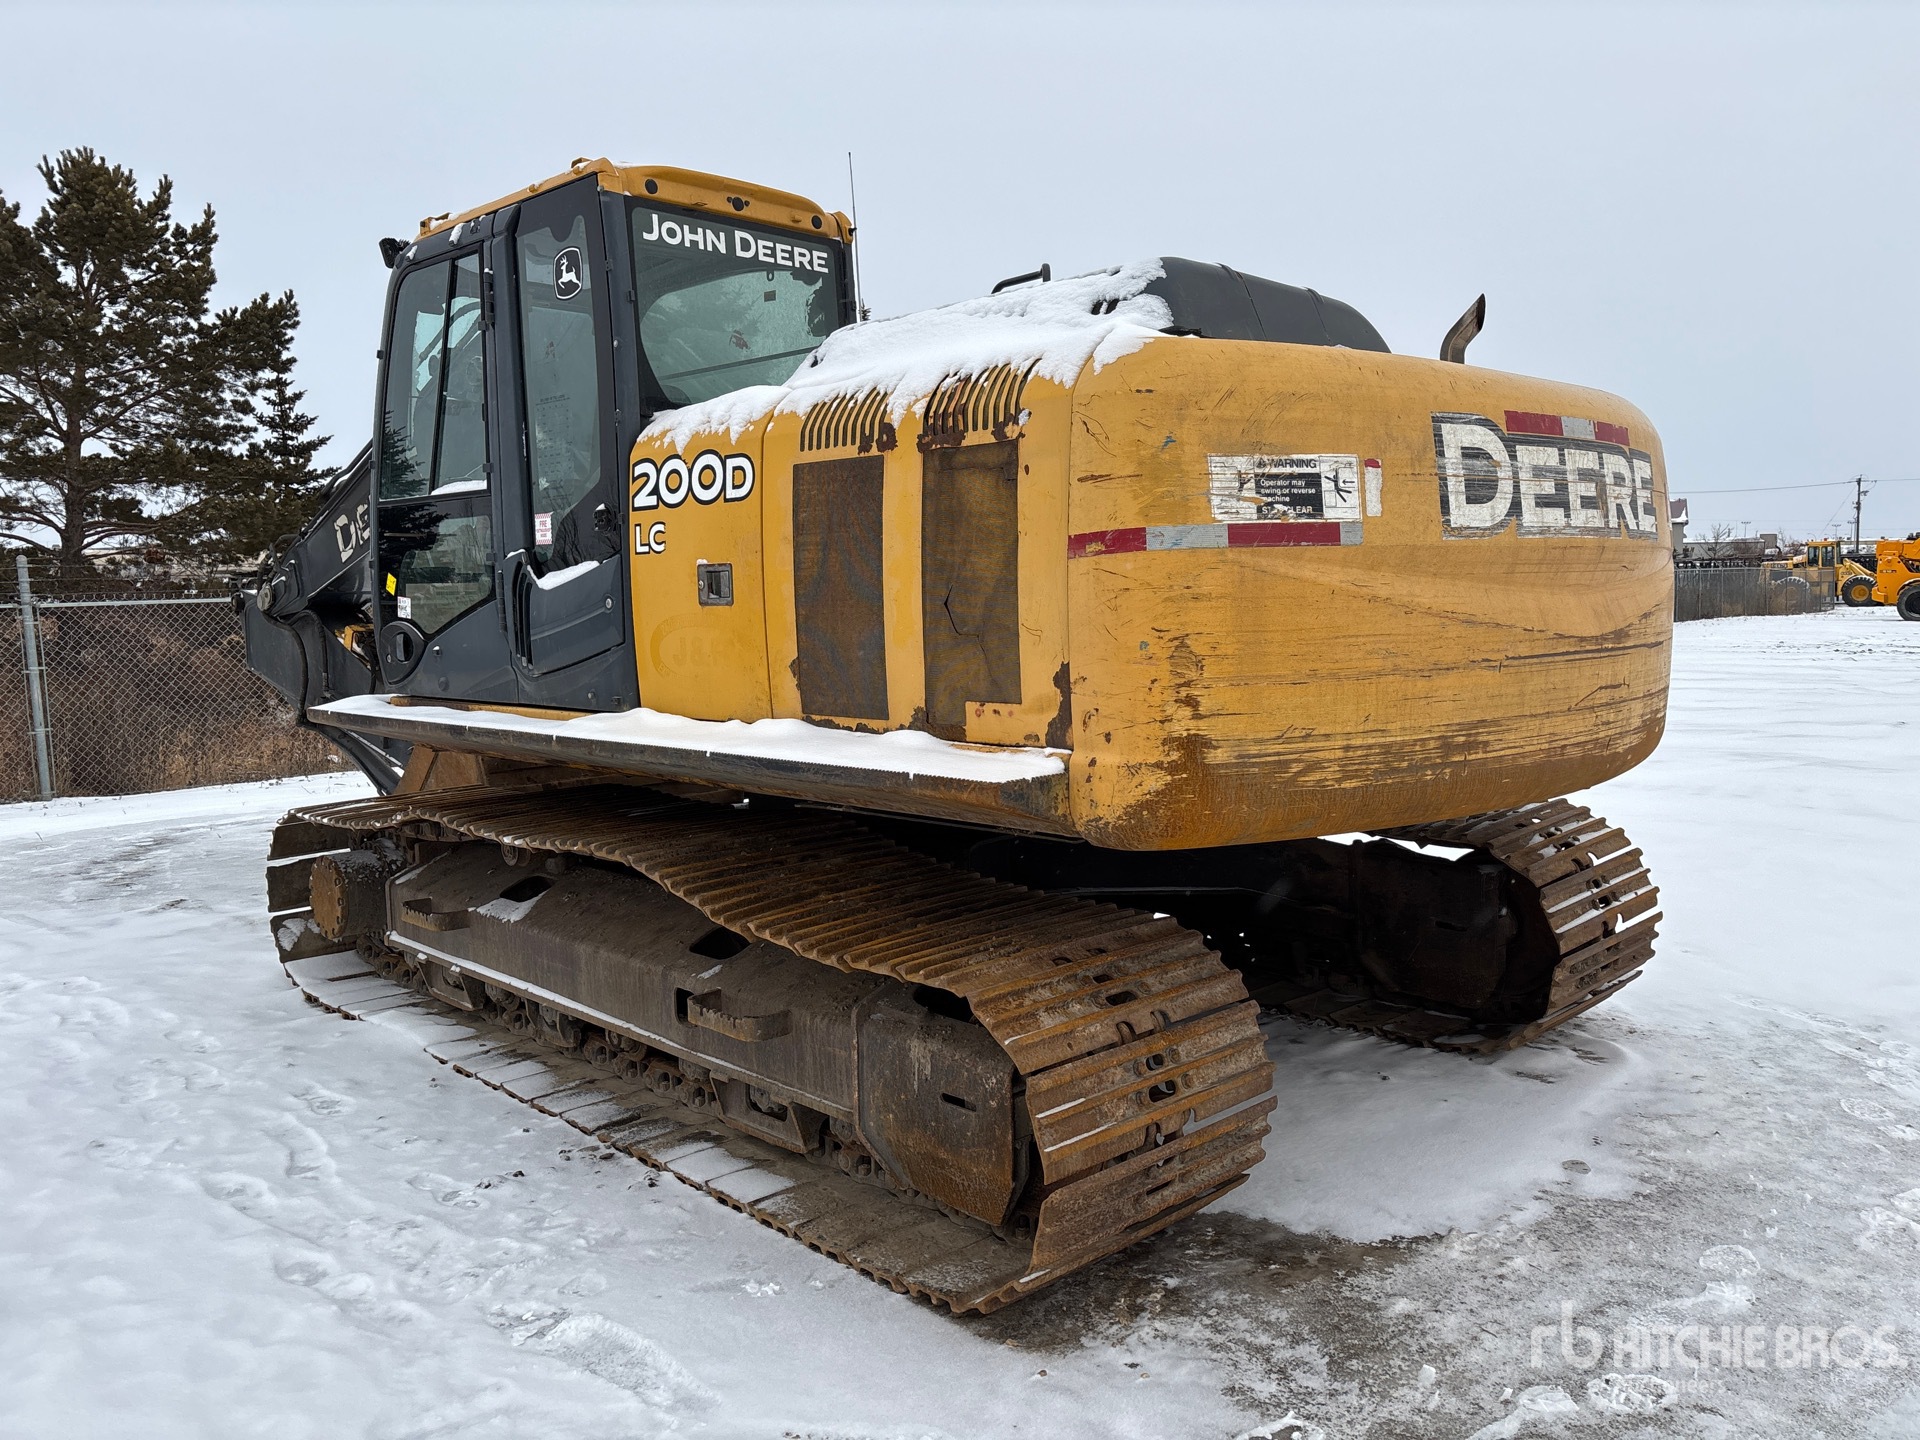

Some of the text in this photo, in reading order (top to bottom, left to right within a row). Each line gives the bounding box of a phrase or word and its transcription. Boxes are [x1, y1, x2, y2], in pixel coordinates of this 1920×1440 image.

[643, 213, 829, 274] JOHN DEERE
[632, 450, 755, 510] 200D
[1260, 479, 1290, 487] Operator
[1260, 488, 1281, 496] swing
[1440, 423, 1657, 533] DEERE
[635, 523, 666, 555] LC
